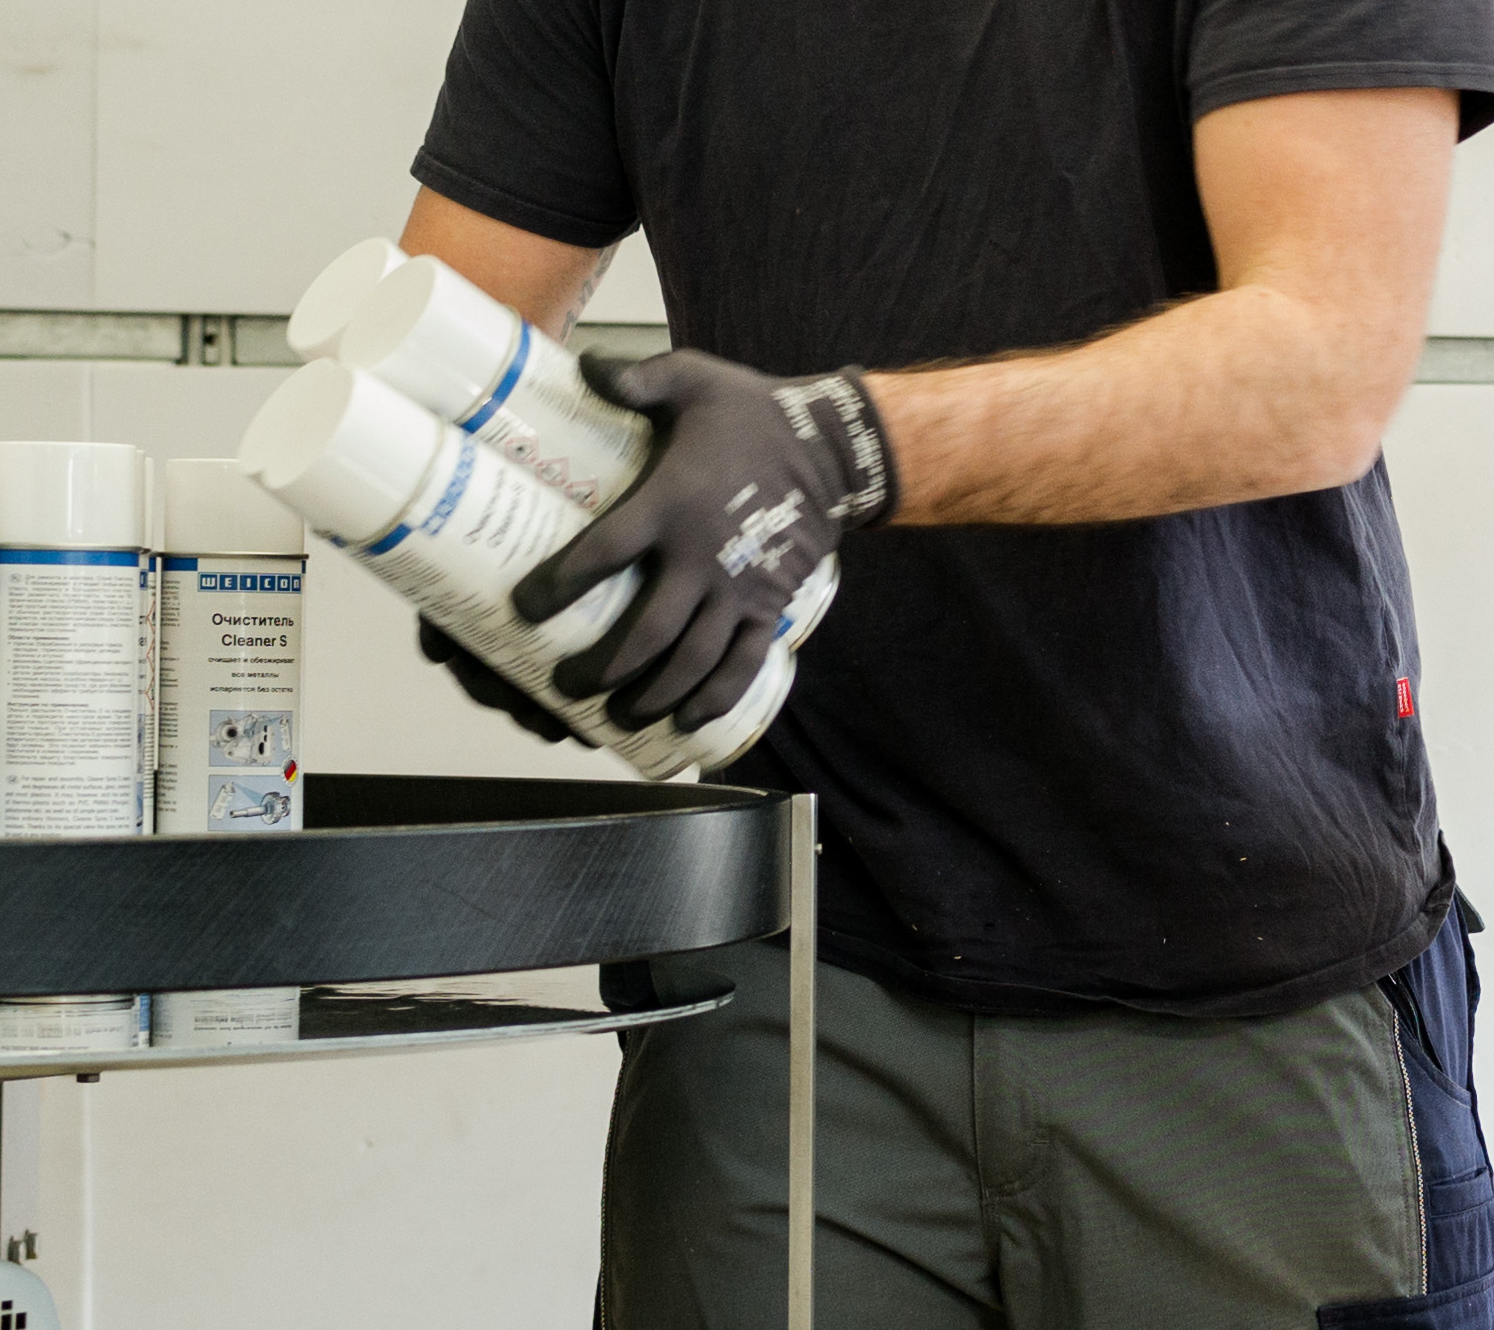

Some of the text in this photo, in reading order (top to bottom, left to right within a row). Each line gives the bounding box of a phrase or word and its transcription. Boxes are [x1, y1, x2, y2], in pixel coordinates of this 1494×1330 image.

[199, 574, 301, 592] WEICON
[212, 613, 294, 627] Очиститель
[221, 634, 288, 647] Cleaner S
